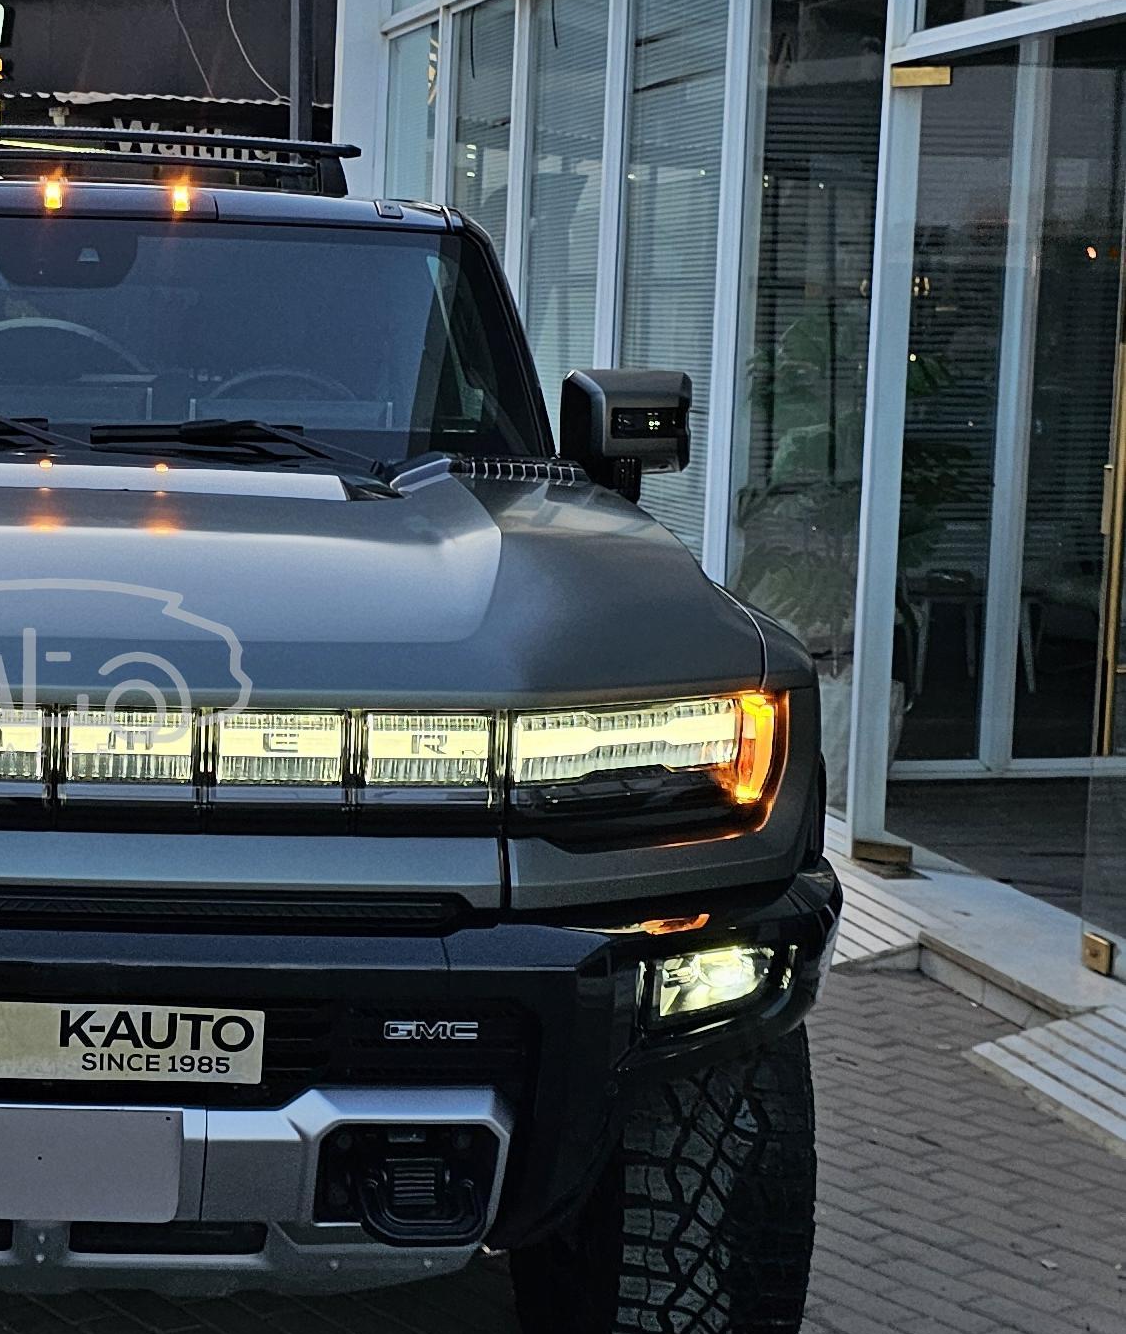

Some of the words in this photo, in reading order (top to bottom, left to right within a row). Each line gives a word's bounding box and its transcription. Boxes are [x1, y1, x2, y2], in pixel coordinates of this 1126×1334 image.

[59, 1009, 255, 1053] K-AUTO
[383, 1020, 480, 1040] GMC
[81, 1052, 161, 1072] SINCE
[168, 1055, 231, 1074] 1985
